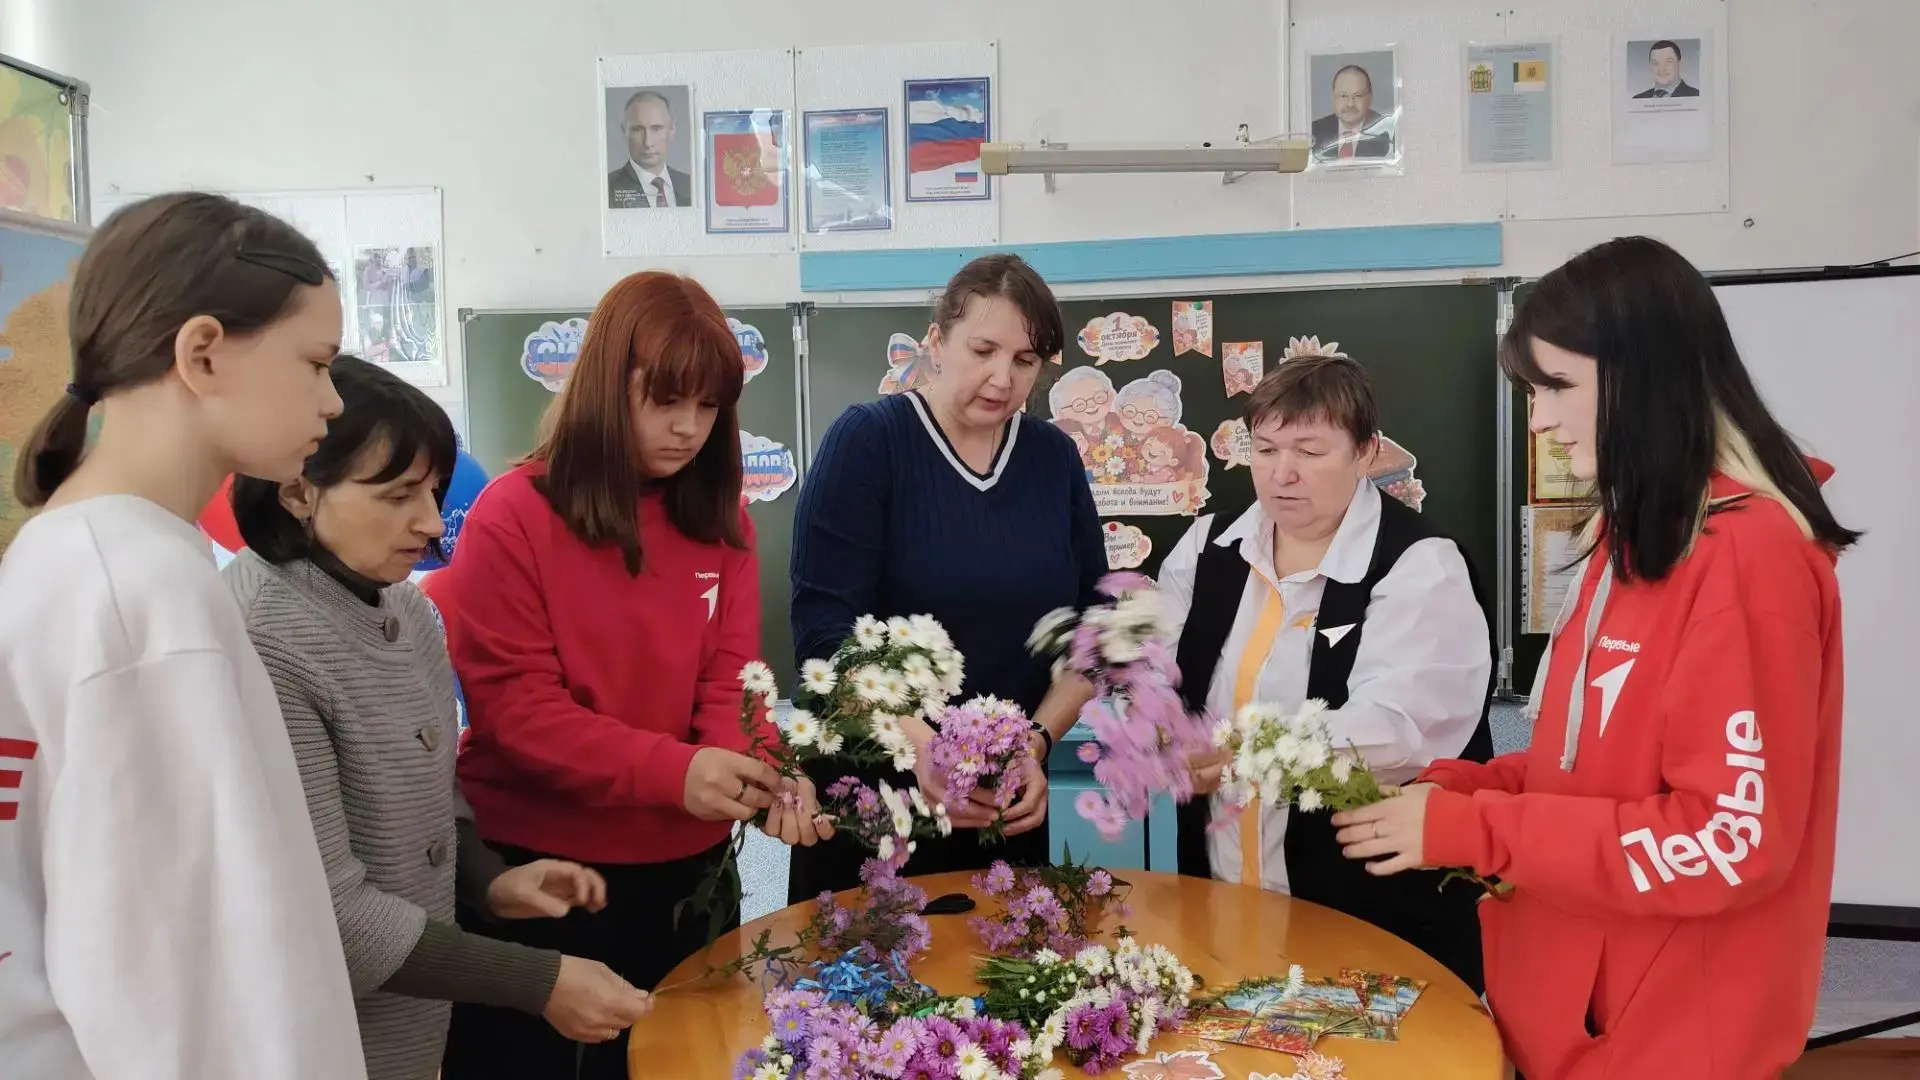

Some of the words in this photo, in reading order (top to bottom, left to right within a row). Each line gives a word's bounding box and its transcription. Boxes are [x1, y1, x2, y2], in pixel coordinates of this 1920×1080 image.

[1112, 316, 1122, 332] 1
[1101, 329, 1138, 341] октября
[1113, 486, 1137, 496] всегда
[1140, 486, 1162, 497] будут
[1129, 495, 1169, 506] внимание!
[1109, 540, 1137, 552] пример!
[1598, 635, 1641, 652] Первые
[1620, 710, 1765, 892] Первые
